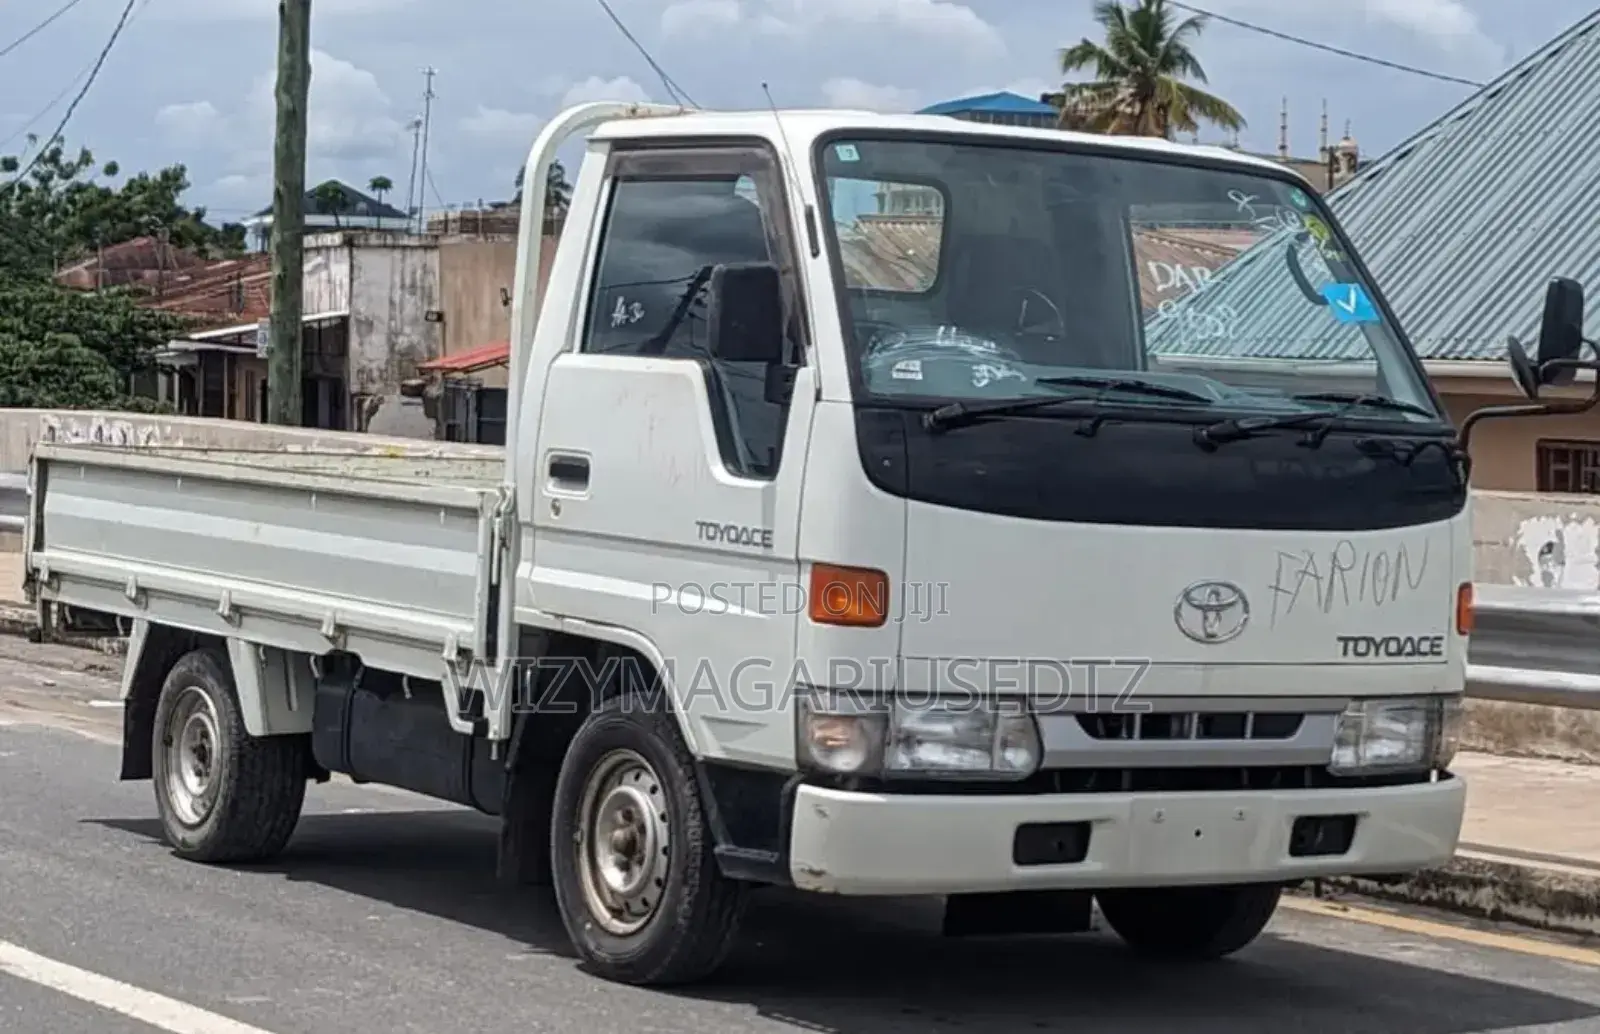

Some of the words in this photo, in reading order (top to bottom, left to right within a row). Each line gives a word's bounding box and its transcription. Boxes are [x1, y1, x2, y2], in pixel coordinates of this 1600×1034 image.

[695, 520, 774, 548] TOYOACE
[1268, 537, 1430, 630] FARION
[1337, 636, 1444, 657] TOYOACE
